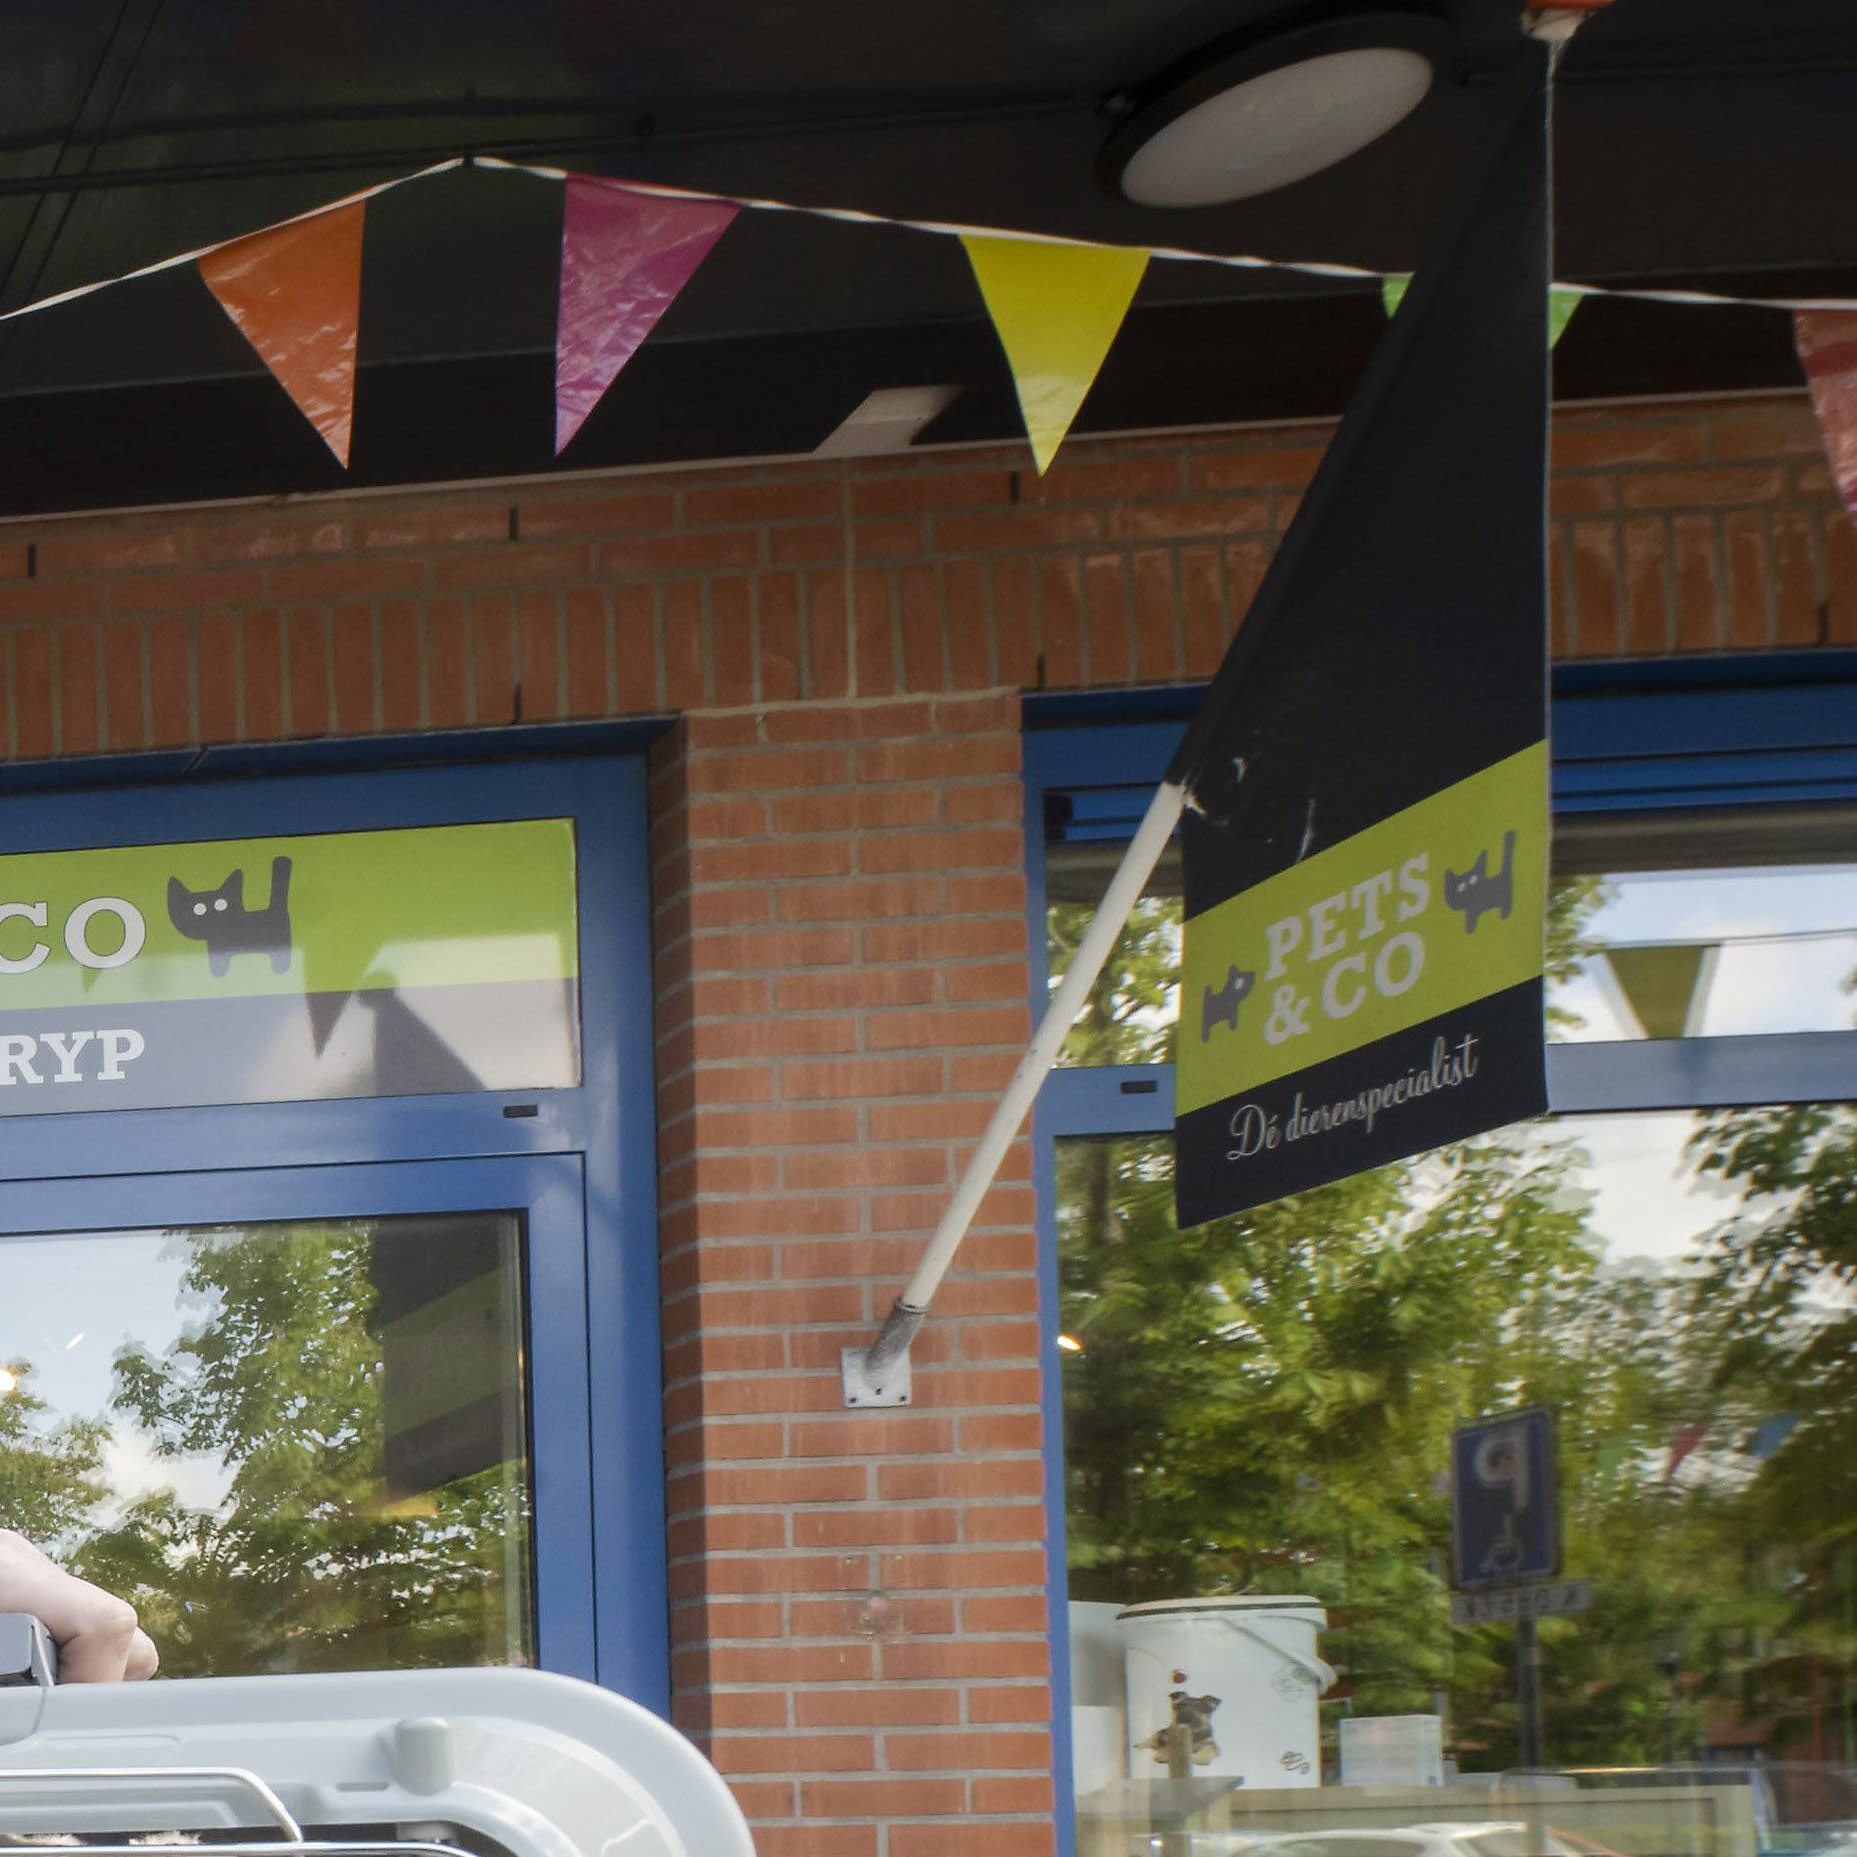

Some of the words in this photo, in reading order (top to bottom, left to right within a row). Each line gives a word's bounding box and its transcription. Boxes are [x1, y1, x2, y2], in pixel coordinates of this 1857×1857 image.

[1264, 851, 1429, 981] PETS
[1227, 1104, 1280, 1160] Dé
[1286, 1033, 1480, 1142] dierenspecialist
